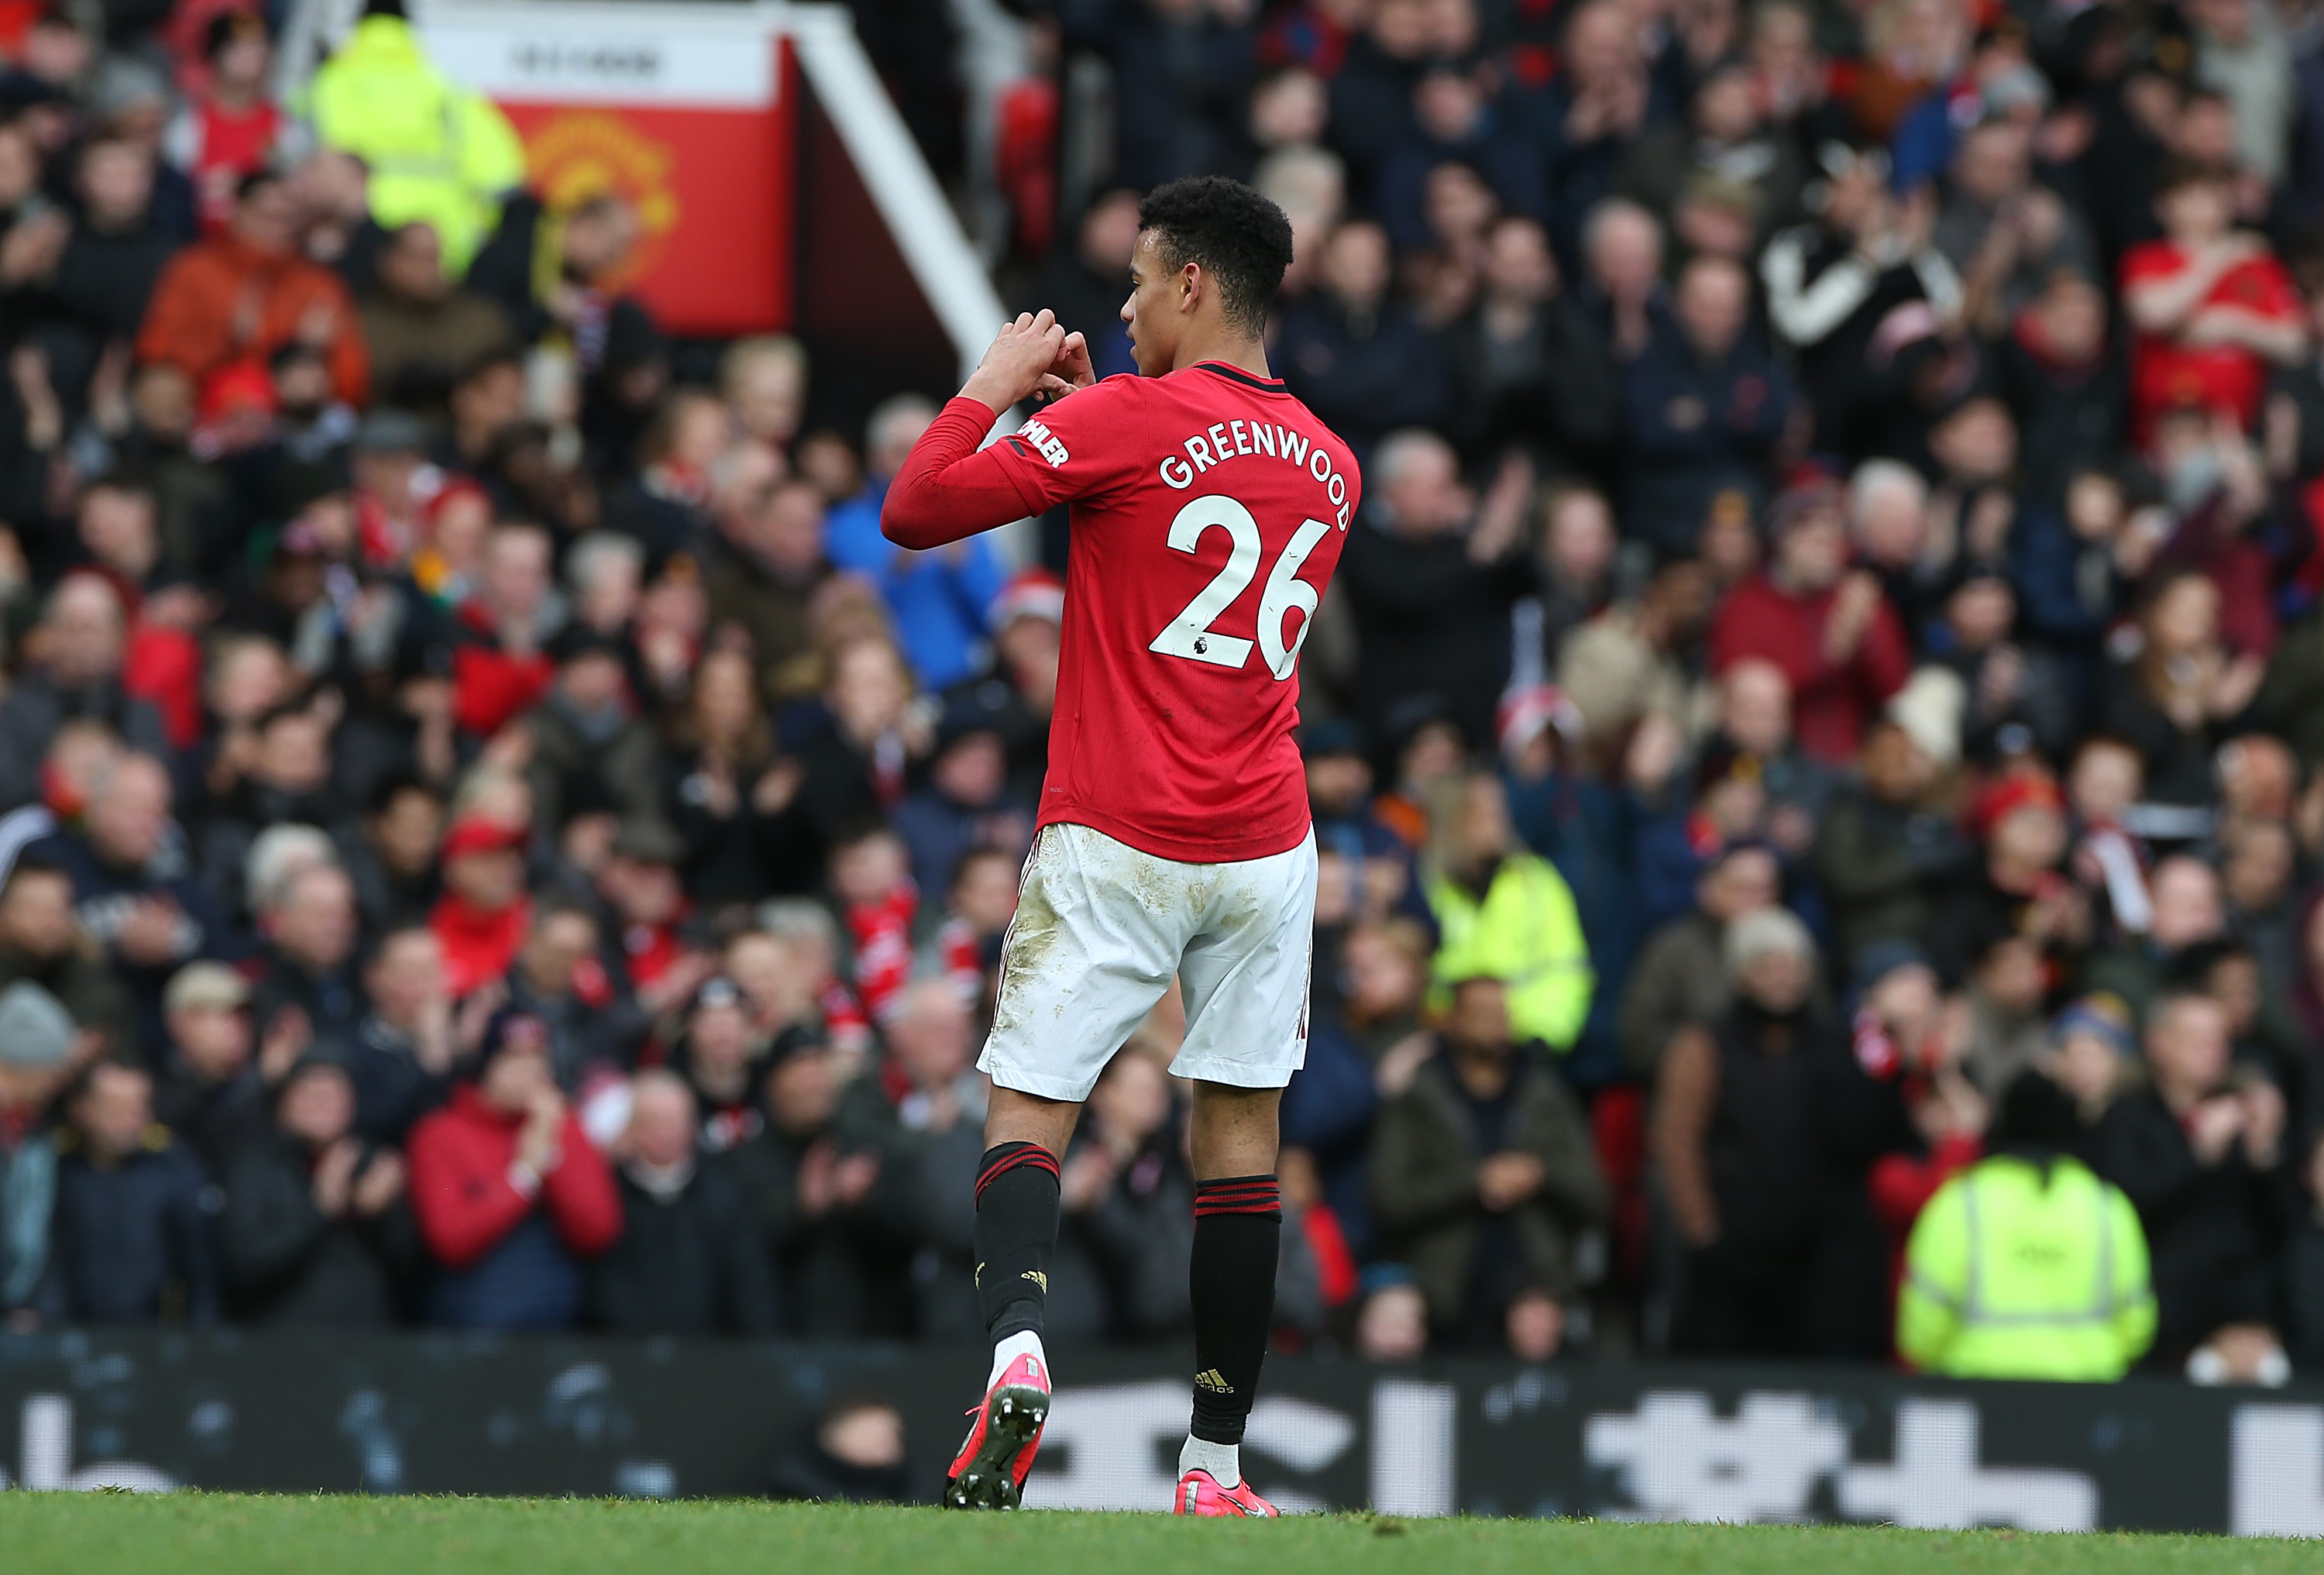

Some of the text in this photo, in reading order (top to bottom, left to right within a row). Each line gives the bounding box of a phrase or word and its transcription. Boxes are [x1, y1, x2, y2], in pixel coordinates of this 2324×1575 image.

[1159, 419, 1349, 531] GREENWOOD
[1148, 494, 1332, 681] 26
[1195, 1375, 1234, 1393] adidas
